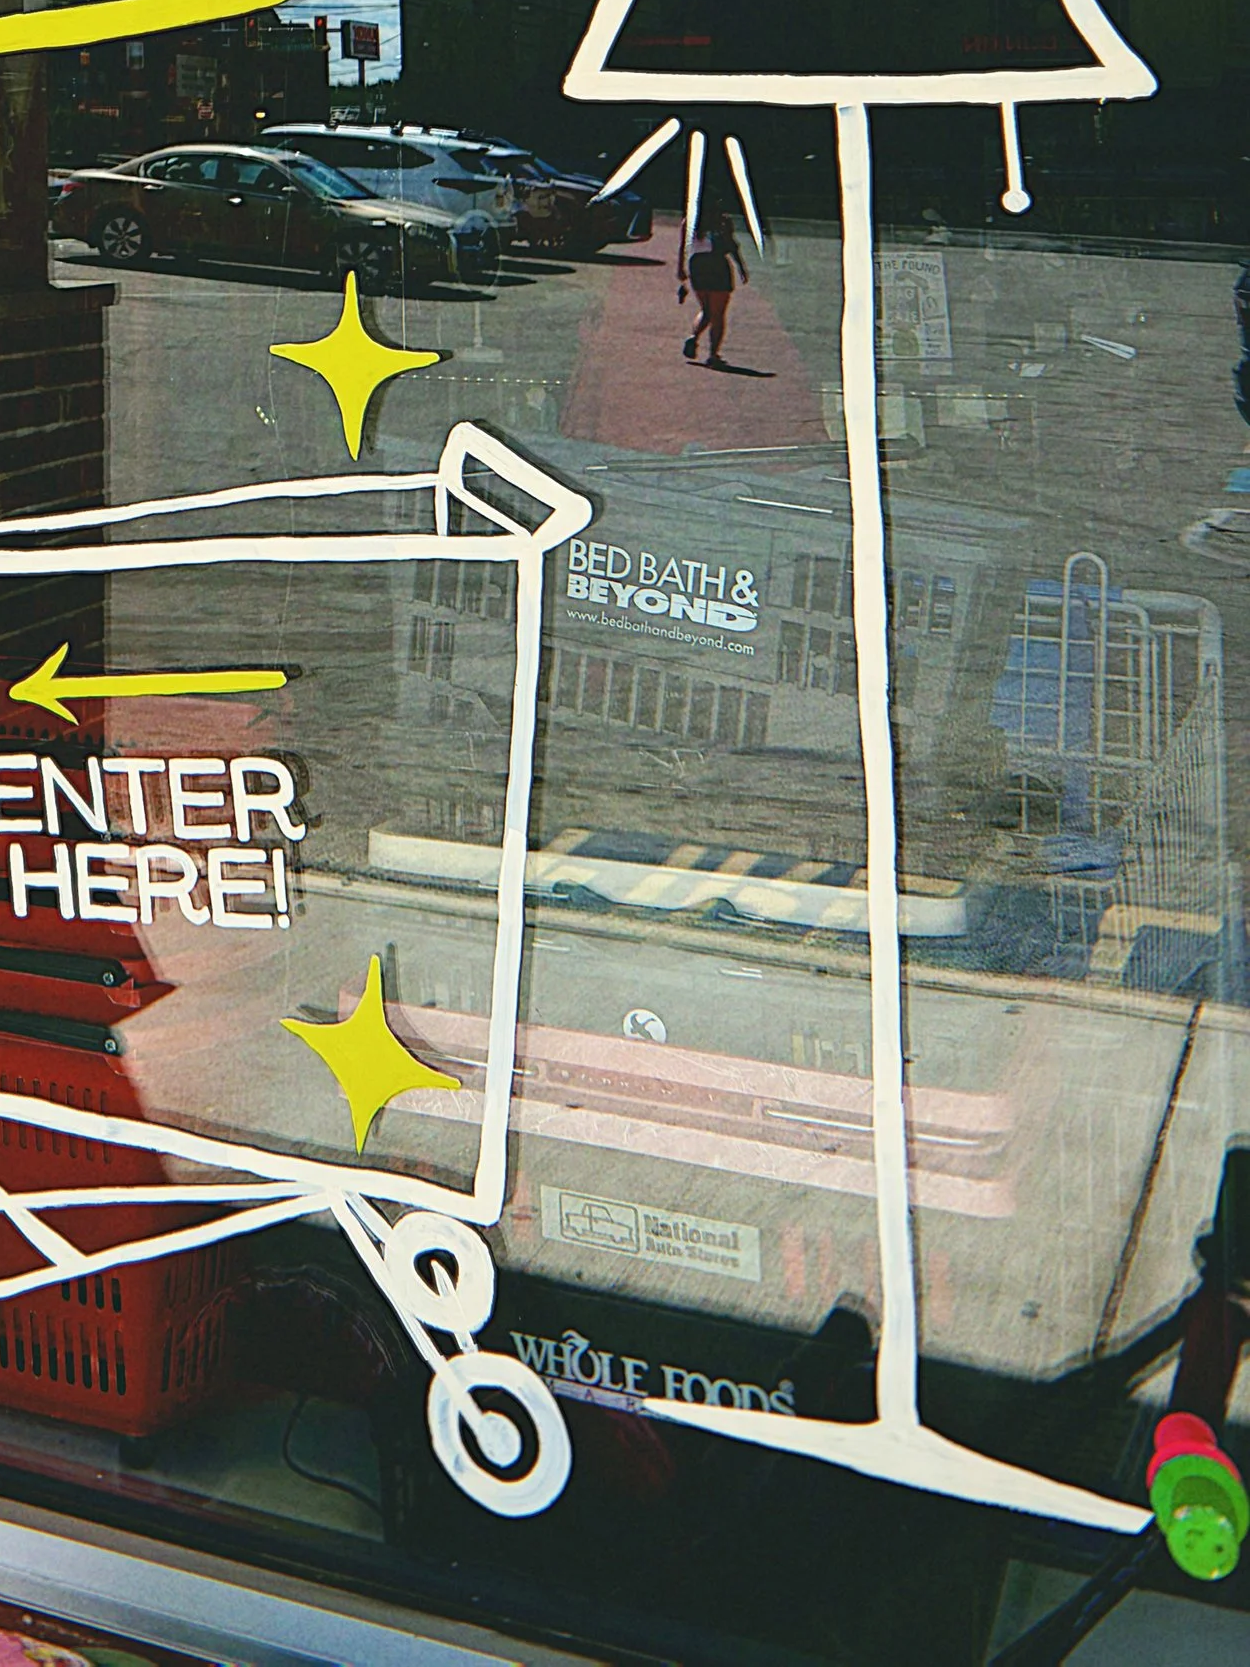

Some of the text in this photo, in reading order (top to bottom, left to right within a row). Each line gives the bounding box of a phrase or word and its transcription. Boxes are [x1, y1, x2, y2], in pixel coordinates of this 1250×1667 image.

[567, 573, 758, 632] BEYOND
[568, 538, 759, 607] BED BATH &
[567, 608, 755, 656] www.bedbathandbeyond.com
[9, 842, 291, 930] HERE!
[643, 1213, 740, 1251] National
[510, 1330, 649, 1396] WHOLE
